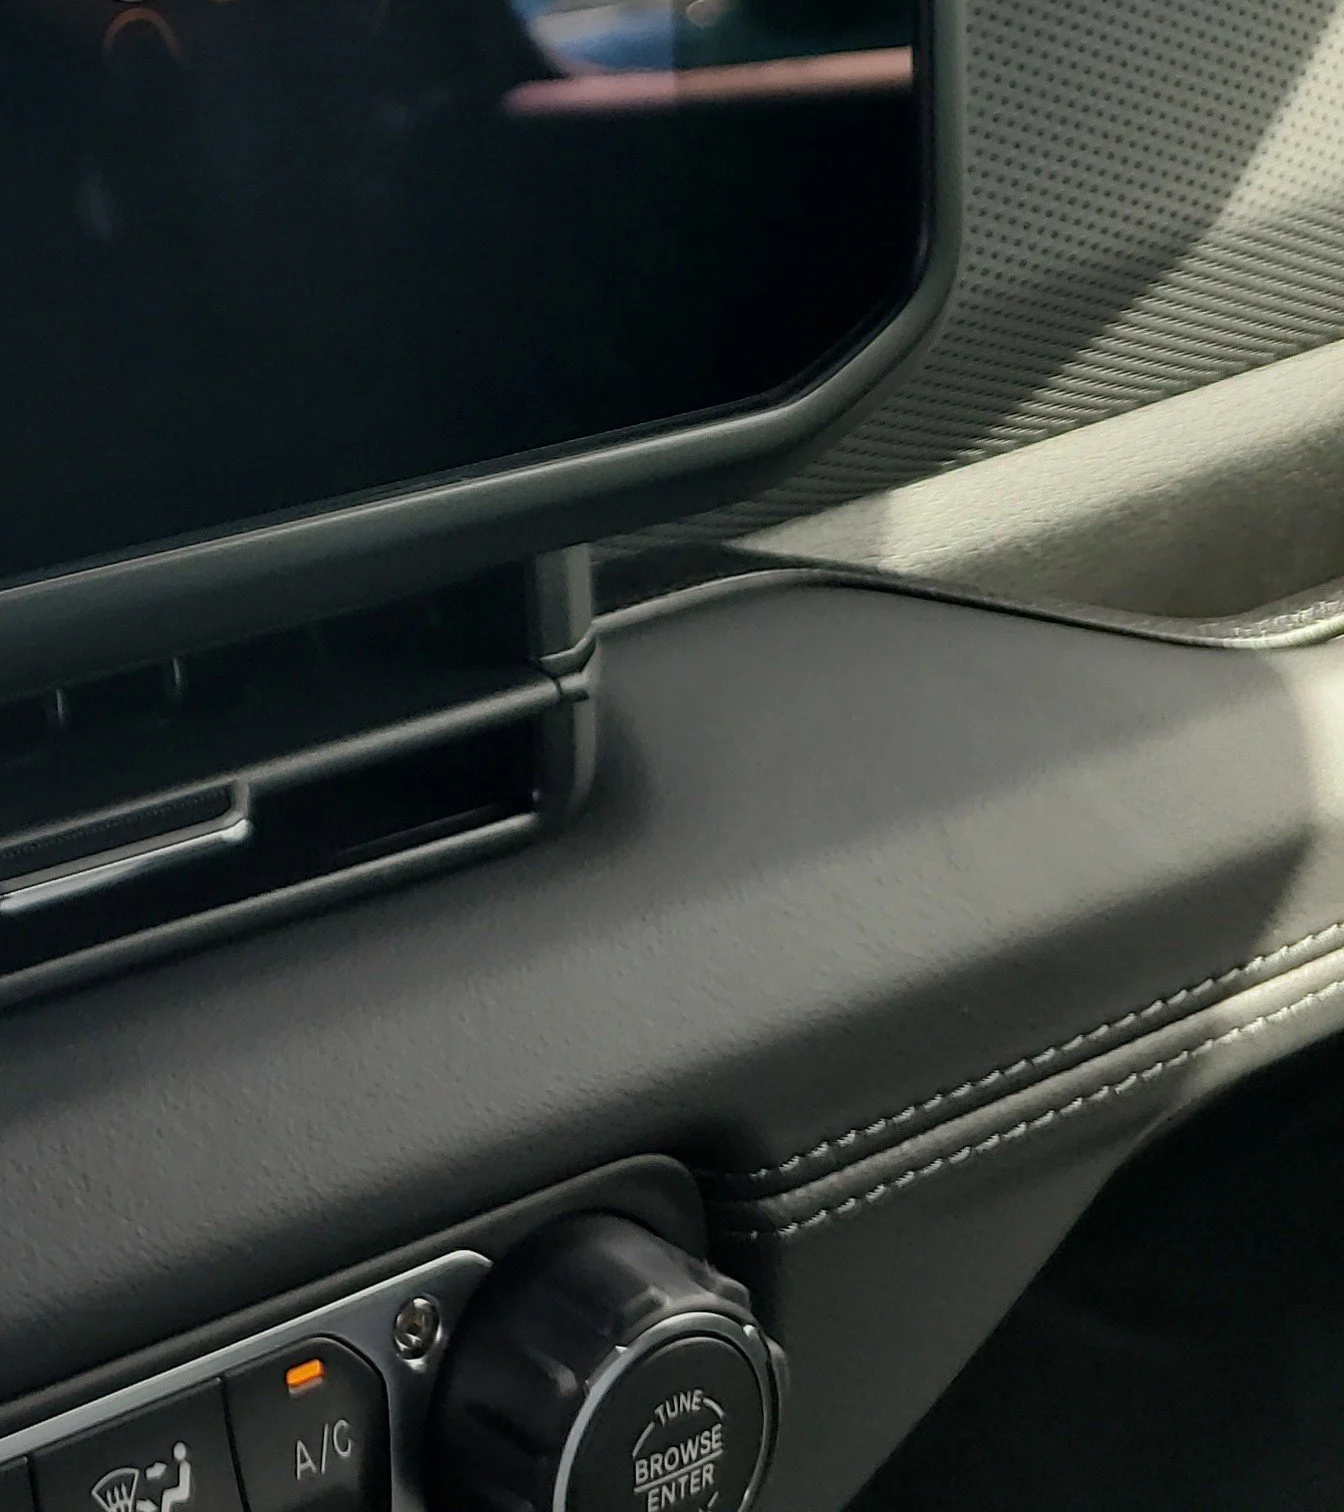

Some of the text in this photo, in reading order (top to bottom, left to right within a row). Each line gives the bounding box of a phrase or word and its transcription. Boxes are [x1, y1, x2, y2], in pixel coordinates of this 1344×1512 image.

[653, 1388, 704, 1427] TUNE
[295, 1418, 353, 1481] A/C
[634, 1422, 724, 1486] BROWSE
[647, 1463, 715, 1512] ENTER
